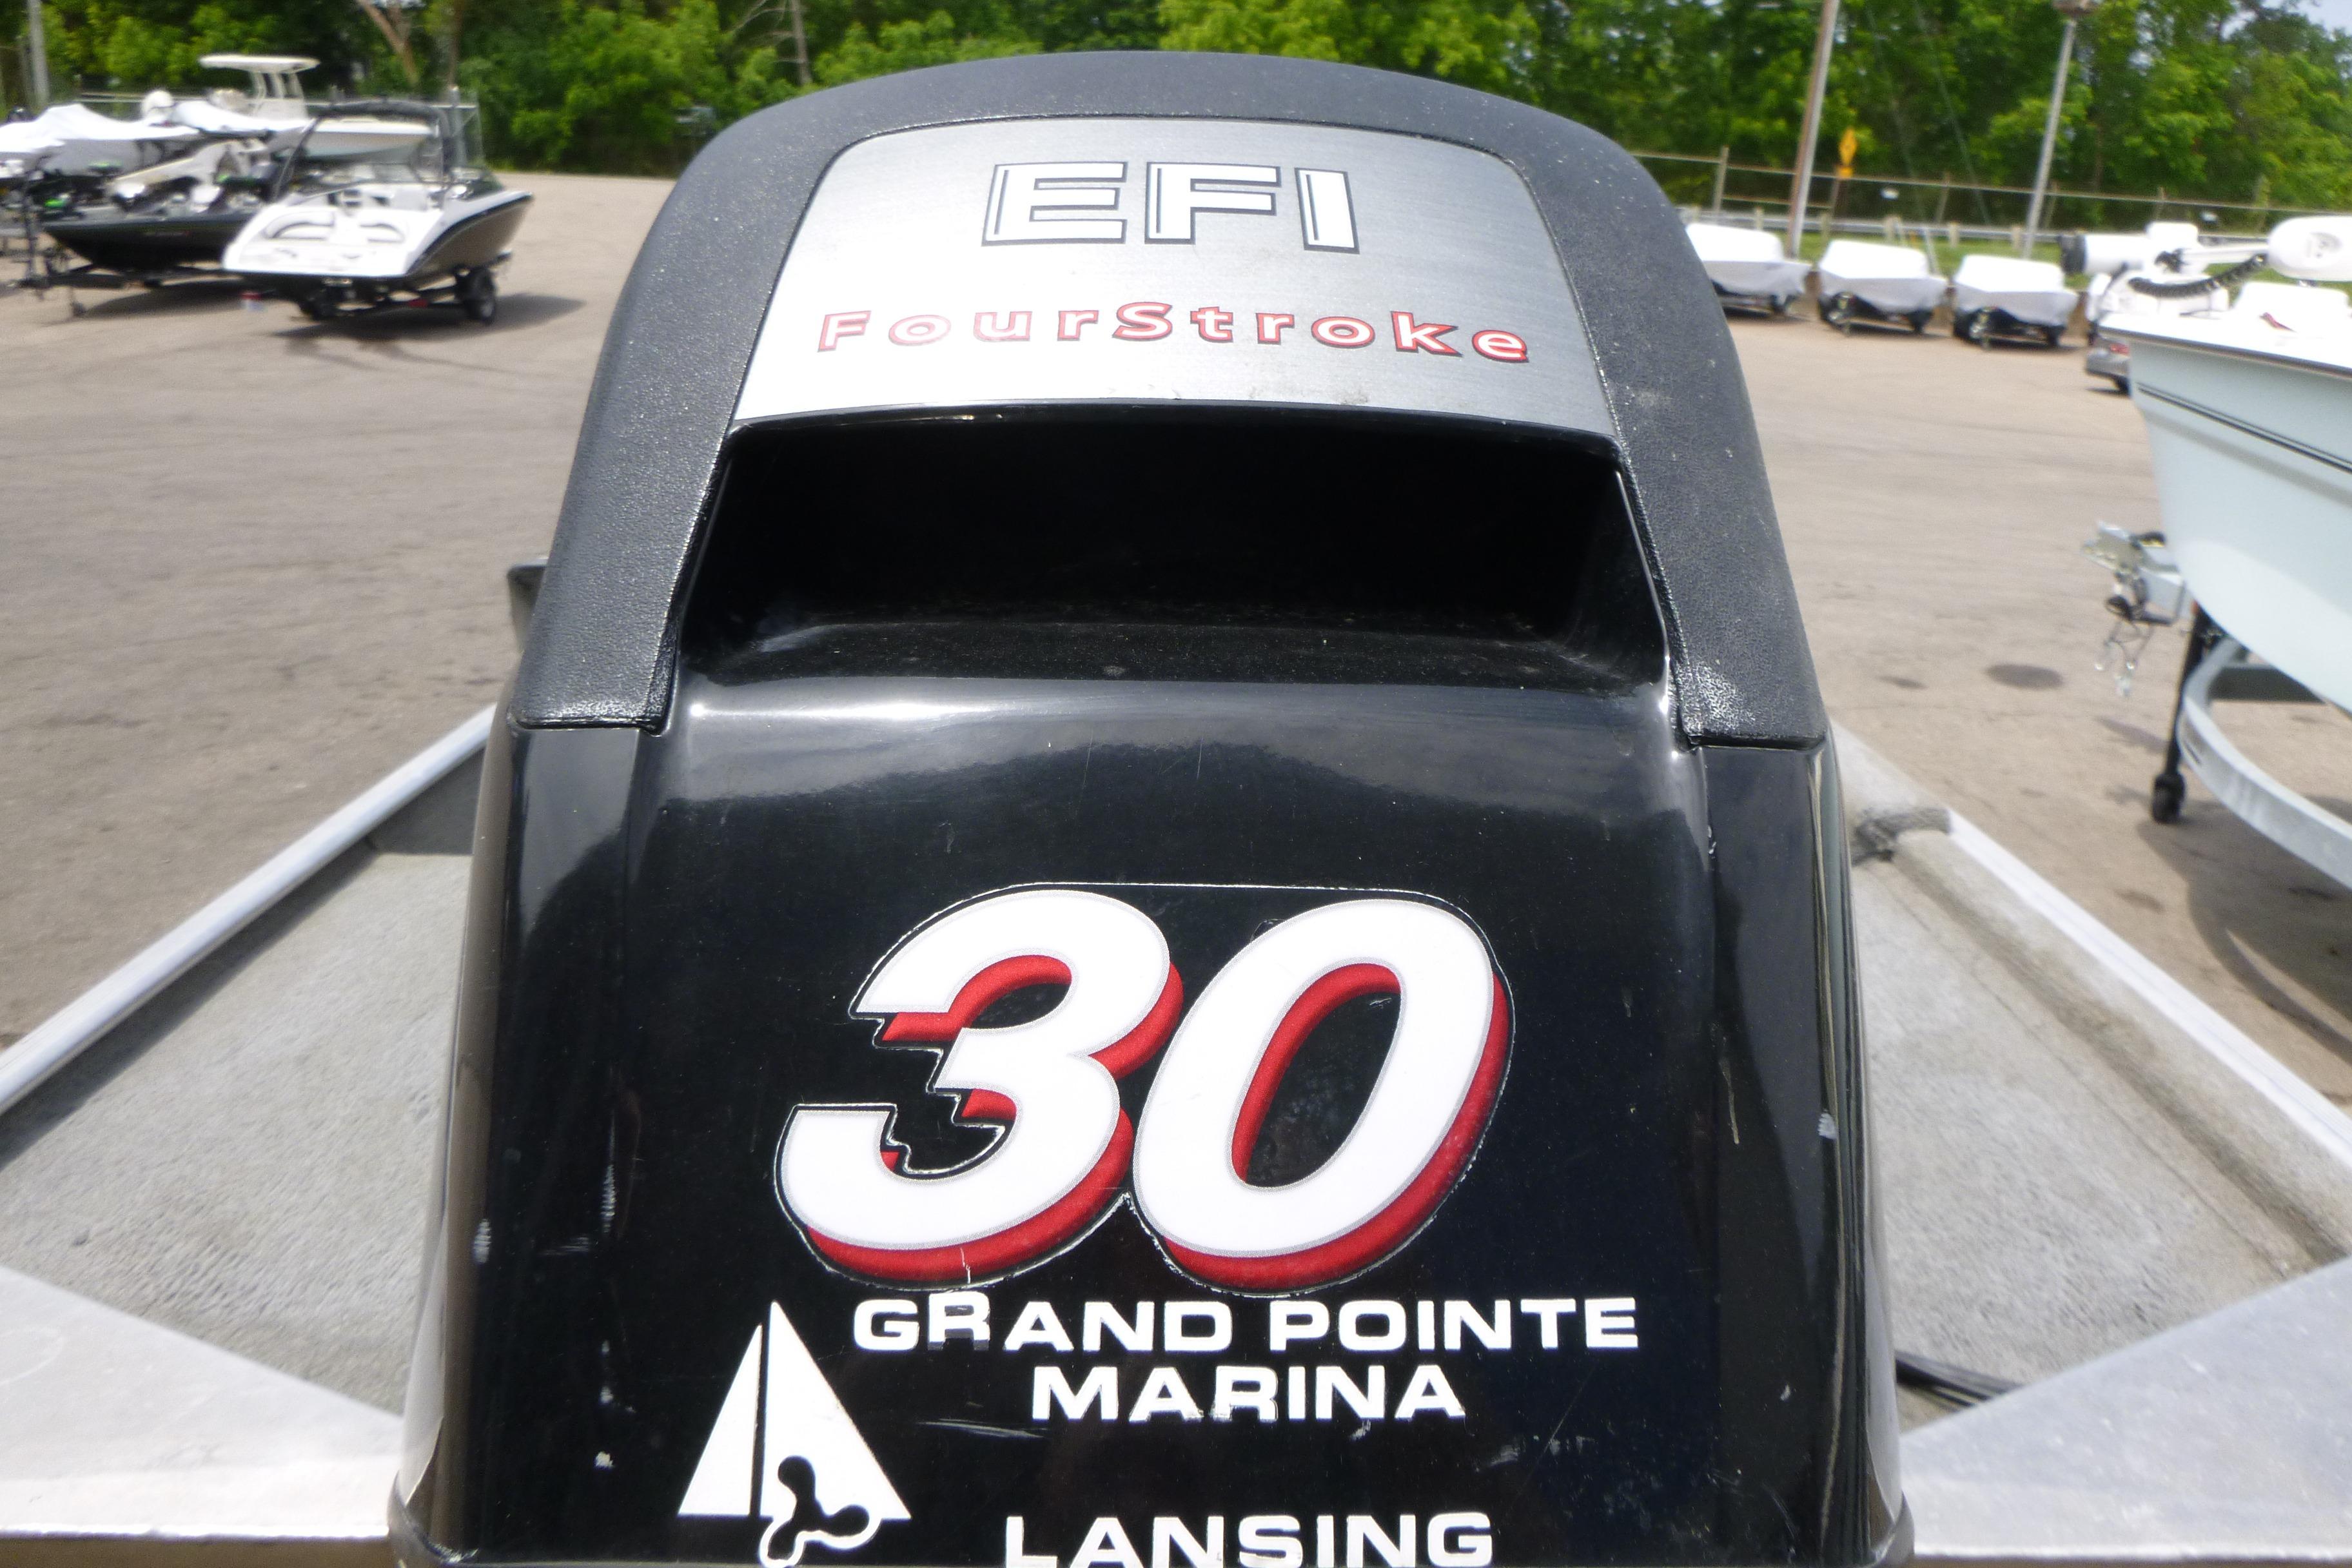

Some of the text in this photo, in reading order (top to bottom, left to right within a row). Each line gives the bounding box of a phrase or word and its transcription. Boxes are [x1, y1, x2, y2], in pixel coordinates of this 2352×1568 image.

[982, 162, 1360, 253] EFI
[818, 302, 1530, 363] FourStroke
[779, 888, 1509, 1285] 30
[853, 1292, 1638, 1351] GRAND POINTE
[1032, 1366, 1465, 1422] MARINA
[1005, 1513, 1493, 1567] LANSING
